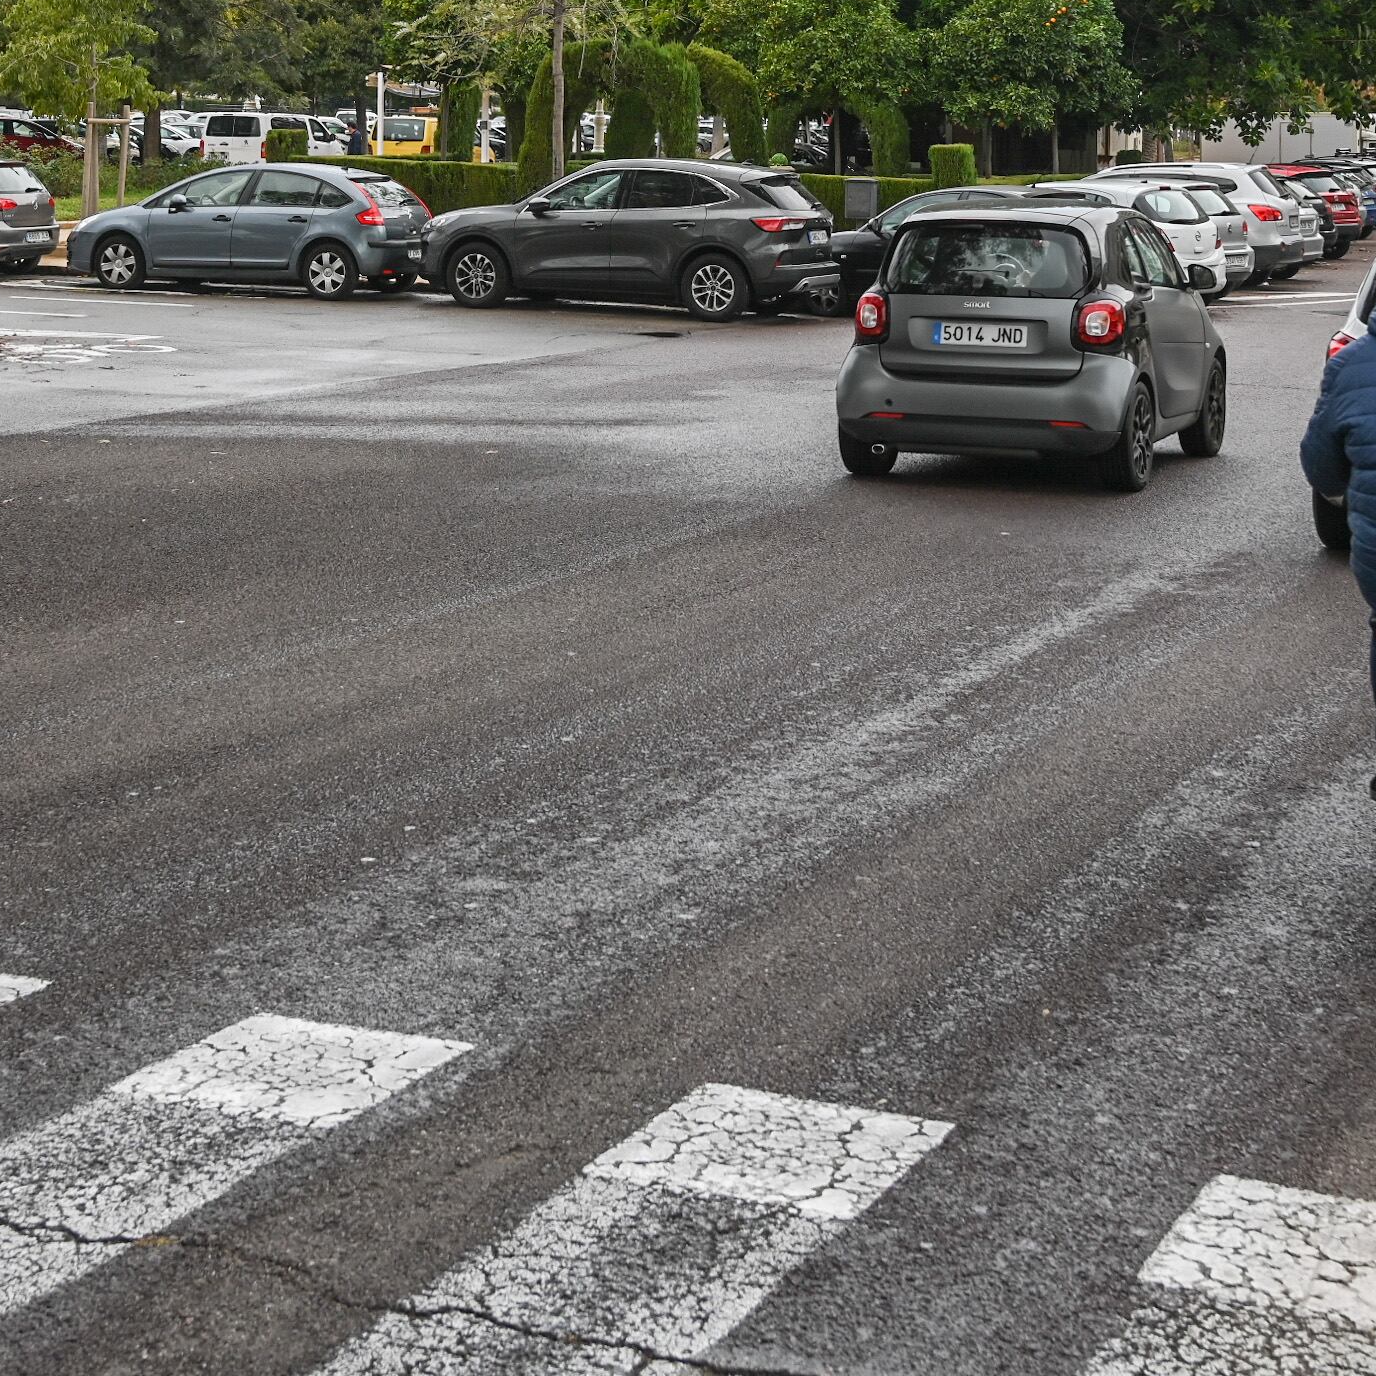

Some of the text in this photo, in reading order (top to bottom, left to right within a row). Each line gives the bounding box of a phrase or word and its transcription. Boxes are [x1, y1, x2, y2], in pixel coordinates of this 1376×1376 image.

[963, 301, 991, 309] smart
[943, 325, 1024, 344] 5014 JND
